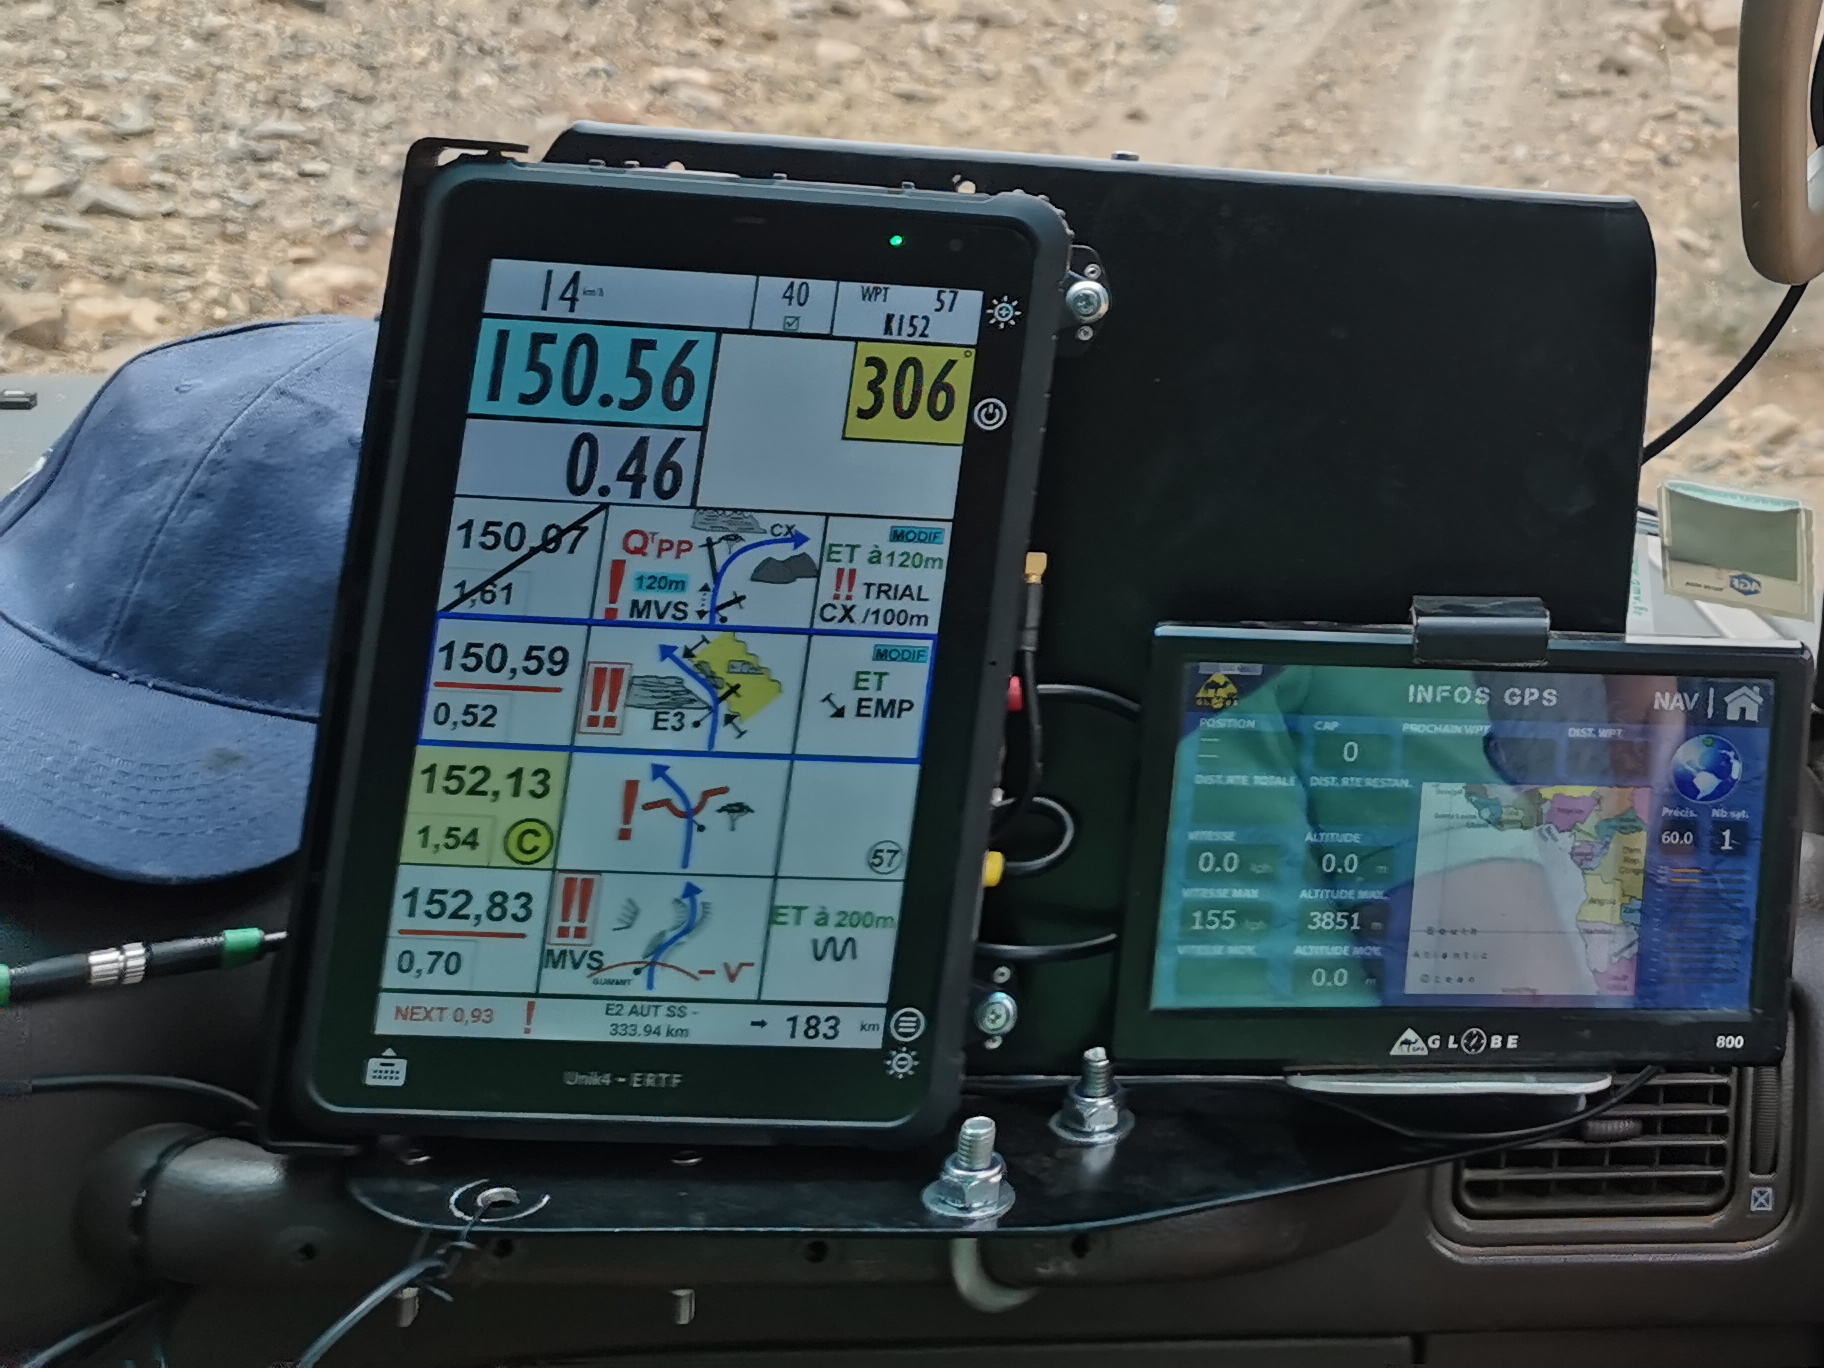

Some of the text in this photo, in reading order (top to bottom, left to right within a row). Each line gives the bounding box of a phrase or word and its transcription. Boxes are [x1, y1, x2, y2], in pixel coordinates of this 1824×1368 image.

[540, 269, 582, 313] 14
[782, 281, 810, 308] 40
[861, 285, 959, 313] WPT 57
[486, 328, 700, 412] 150.56
[565, 431, 687, 500] 0.46
[770, 522, 797, 538] CX
[891, 527, 944, 545] MODIF
[826, 543, 861, 563] ET
[634, 574, 687, 592] 120m
[862, 582, 930, 602] TRIAL
[629, 598, 689, 621] MVS
[818, 603, 857, 624] CX
[438, 640, 570, 680] 150,59
[875, 646, 928, 663] MODIF
[853, 670, 890, 692] ET
[1408, 684, 1559, 707] INFOS GPS
[1653, 690, 1699, 712] NAV
[433, 701, 498, 731] 0,52
[855, 697, 915, 719] EMP
[652, 710, 686, 732] E3
[1199, 717, 1256, 729] POSITION
[1343, 741, 1359, 762] 0
[419, 762, 552, 803] 152,13
[416, 824, 481, 854] 1,54
[1304, 831, 1362, 843] ALTITUDE
[1661, 830, 1694, 845] 60.0
[1720, 829, 1734, 851] 1
[868, 848, 900, 869] 57
[1198, 851, 1240, 873] 0.0
[1321, 853, 1359, 874] 0.0
[1299, 888, 1355, 900] ALTITUDE
[402, 886, 534, 927] 152,83
[771, 905, 809, 926] ET
[834, 910, 897, 929] 200m
[1191, 909, 1237, 931] 155
[1307, 911, 1361, 931] 3851
[397, 949, 462, 979] 0,70
[544, 948, 605, 972] MVS
[1310, 967, 1349, 987] 0.0
[394, 1004, 448, 1022] NEXT
[452, 1007, 495, 1025] 0,93
[604, 1003, 625, 1017] E2
[628, 1003, 662, 1018] AUT
[665, 1005, 688, 1019] SS
[609, 1022, 690, 1038] 333.94 km
[786, 1014, 880, 1040] 183 km
[1715, 1035, 1744, 1050] 800
